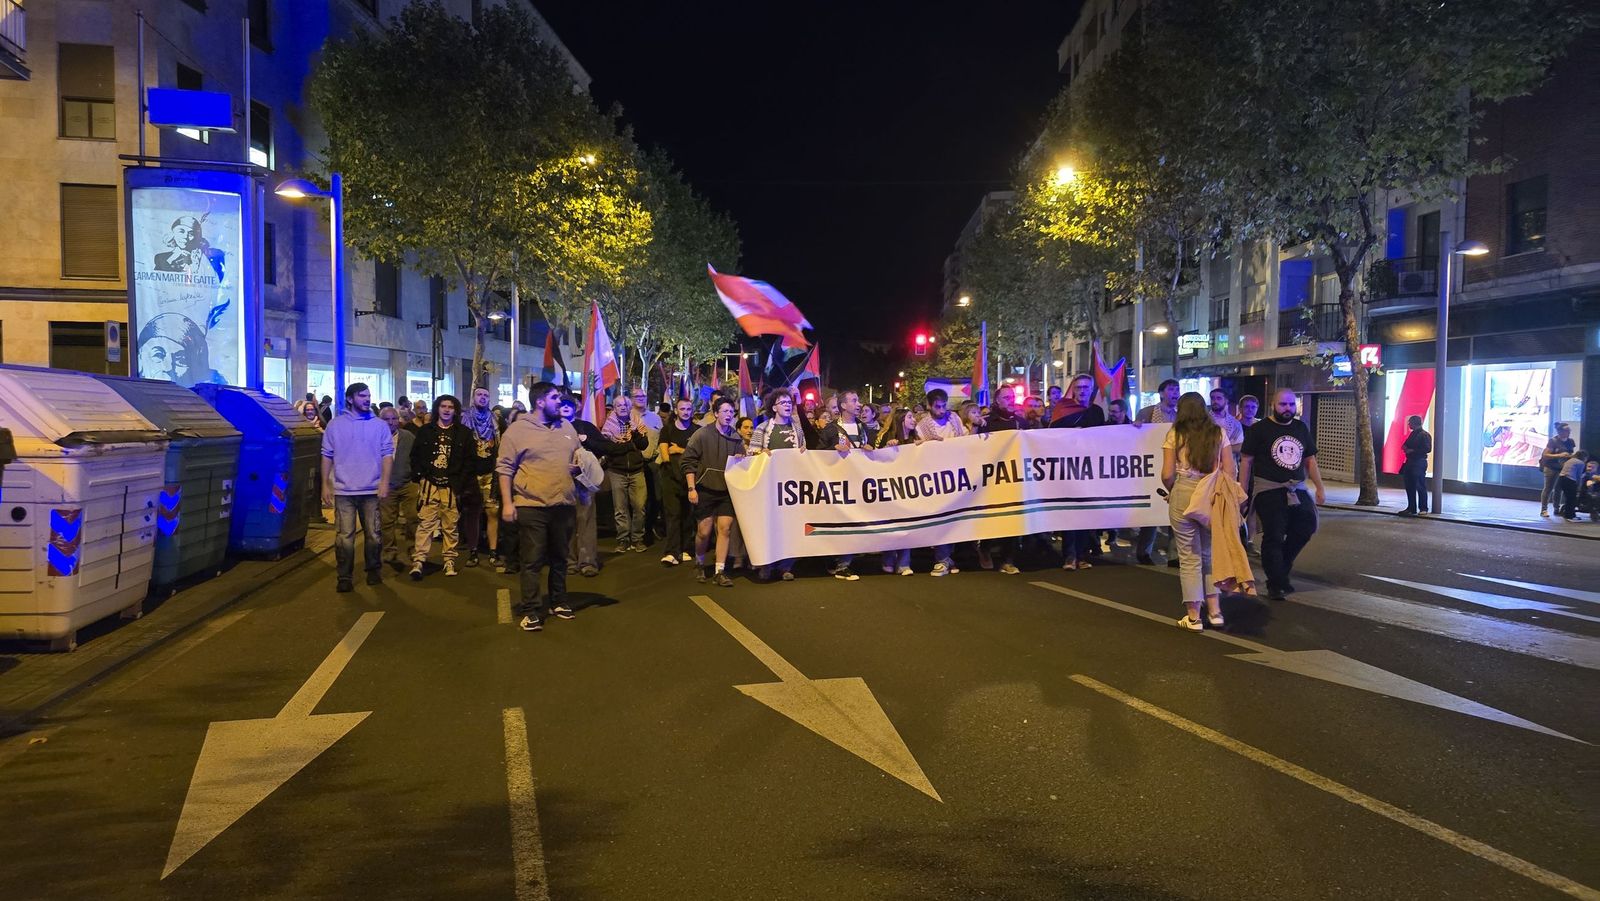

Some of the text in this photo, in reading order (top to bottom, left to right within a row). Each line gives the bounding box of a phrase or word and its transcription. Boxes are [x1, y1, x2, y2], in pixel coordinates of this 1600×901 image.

[193, 275, 216, 285] GAITE
[778, 454, 1155, 506] ISRAEL GENOCIDA, PALESTINA LIBRE
